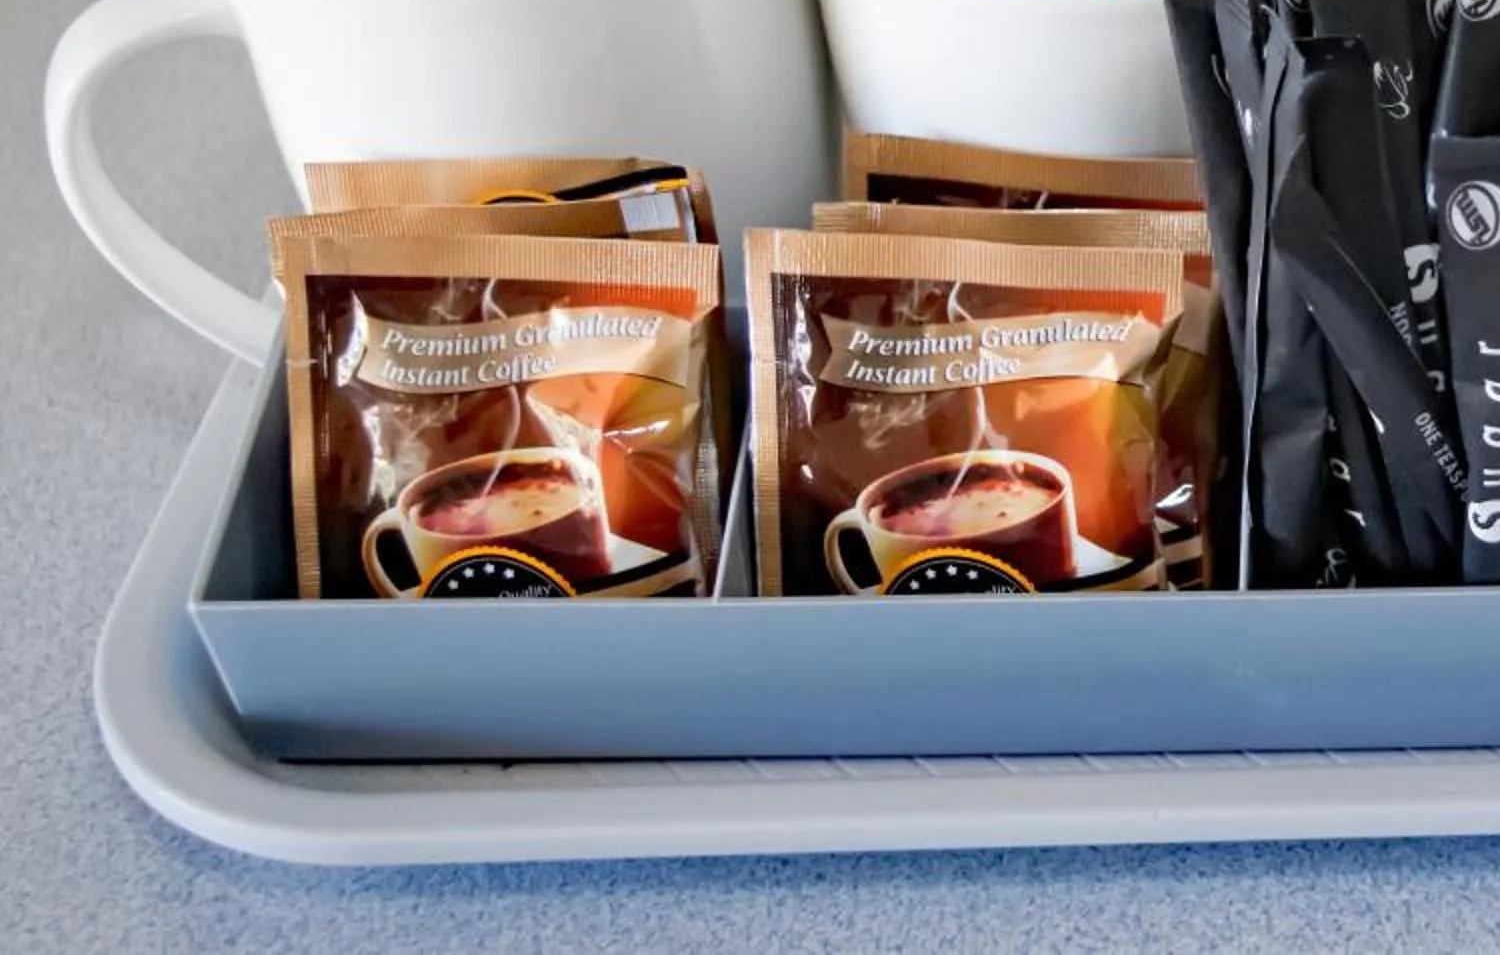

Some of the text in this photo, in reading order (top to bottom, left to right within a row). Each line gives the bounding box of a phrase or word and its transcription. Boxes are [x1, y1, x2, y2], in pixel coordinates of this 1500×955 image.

[381, 316, 663, 357] Premium Granulated
[848, 318, 1134, 357] Premium Granulated
[381, 351, 557, 387] Instant Coffee
[847, 354, 1022, 386] Instant Coffee
[1414, 411, 1444, 446] ONE
